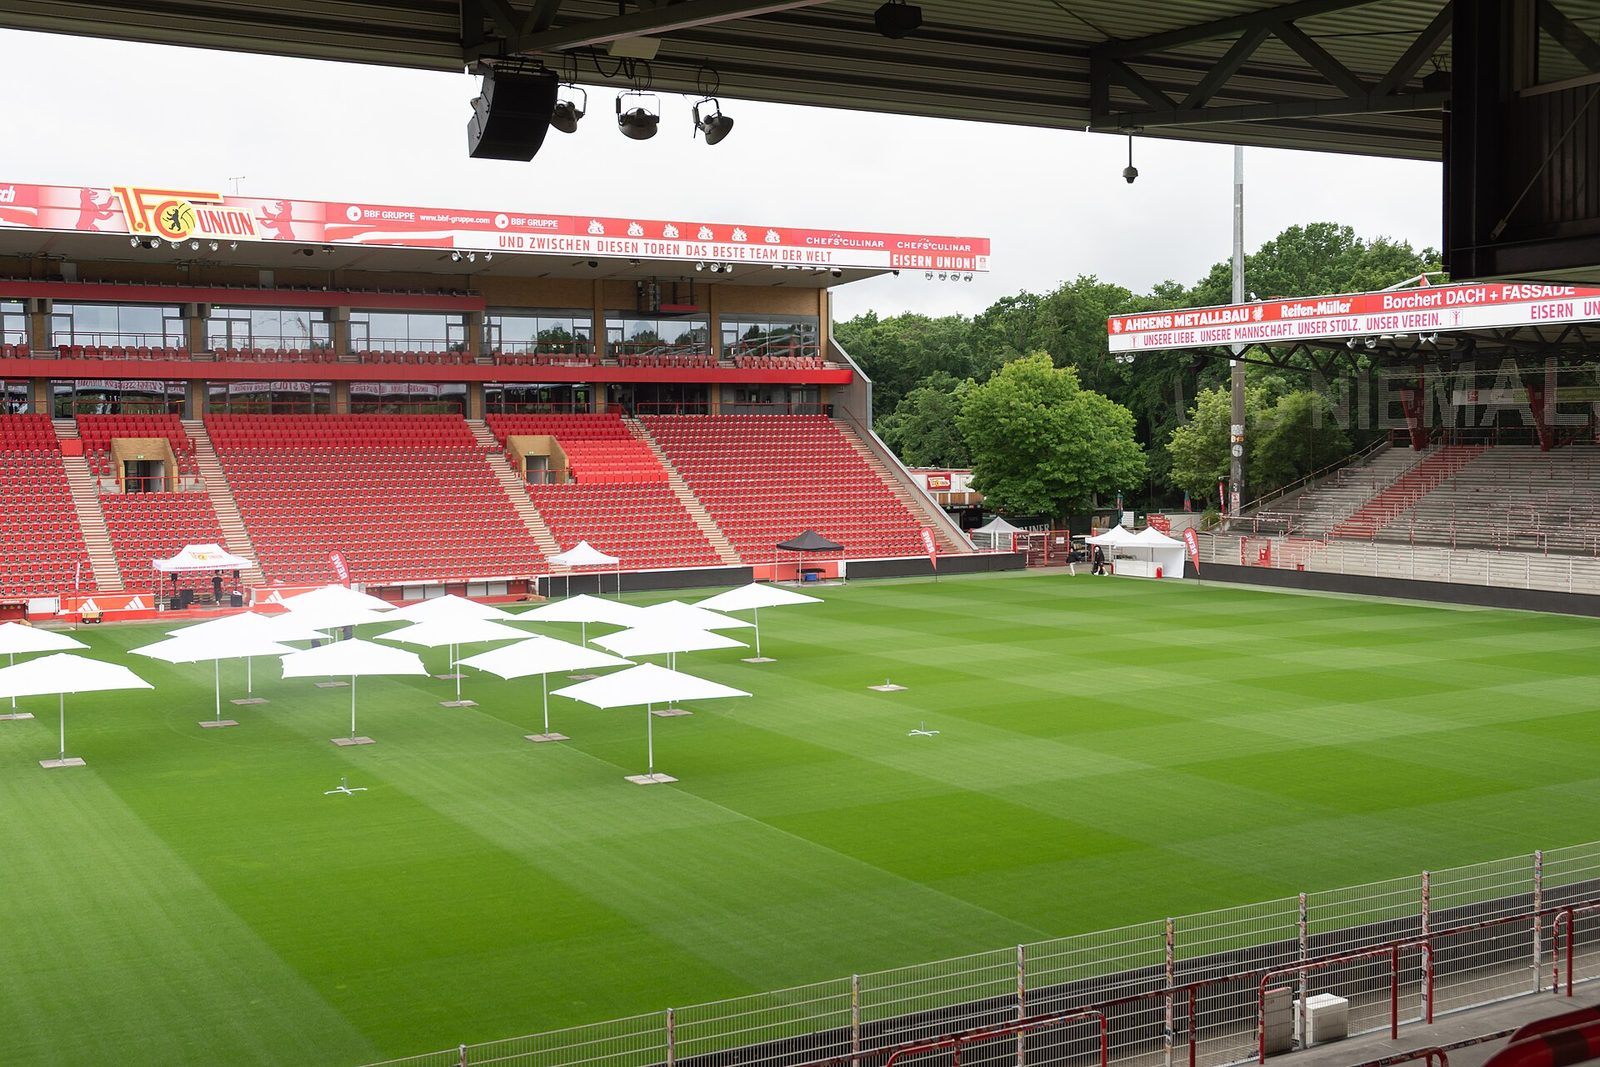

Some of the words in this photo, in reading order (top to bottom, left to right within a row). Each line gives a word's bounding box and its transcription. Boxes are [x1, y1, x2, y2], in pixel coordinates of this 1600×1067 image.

[196, 209, 256, 236] UNION
[363, 209, 380, 218] BBF
[381, 210, 416, 220] GRUPPE
[419, 214, 491, 225] www.bbf-gruppe.com
[511, 217, 527, 226] BBF
[527, 218, 559, 228] GRUPPE
[499, 235, 524, 249] UND
[529, 237, 590, 251] ZWISCHEN
[597, 240, 639, 254] DIESEN
[644, 242, 680, 256] TOREN
[686, 244, 708, 257] DAS
[712, 246, 745, 259] BESTE
[750, 248, 779, 261] TEAM
[782, 250, 802, 262] DER
[806, 251, 832, 263] WELT
[892, 253, 932, 268] EISERN
[936, 255, 976, 269] UNION!
[1383, 292, 1442, 310] Borchert
[1446, 288, 1486, 305] DACH
[1502, 284, 1576, 300] FASSADE
[1124, 315, 1172, 332] AHRENS
[1174, 308, 1249, 328] METALLBAU
[1531, 302, 1574, 320] EISERN
[1143, 334, 1172, 346] UNSERE
[1173, 331, 1198, 344] LIEBE.
[1200, 328, 1231, 342] UNSERE
[1234, 322, 1294, 340] MANNSCHAFT.
[1297, 320, 1327, 335] UNSER
[1330, 318, 1361, 333] STOLZ.
[1366, 315, 1399, 330] UNSER
[1401, 312, 1442, 329] VEREIN.
